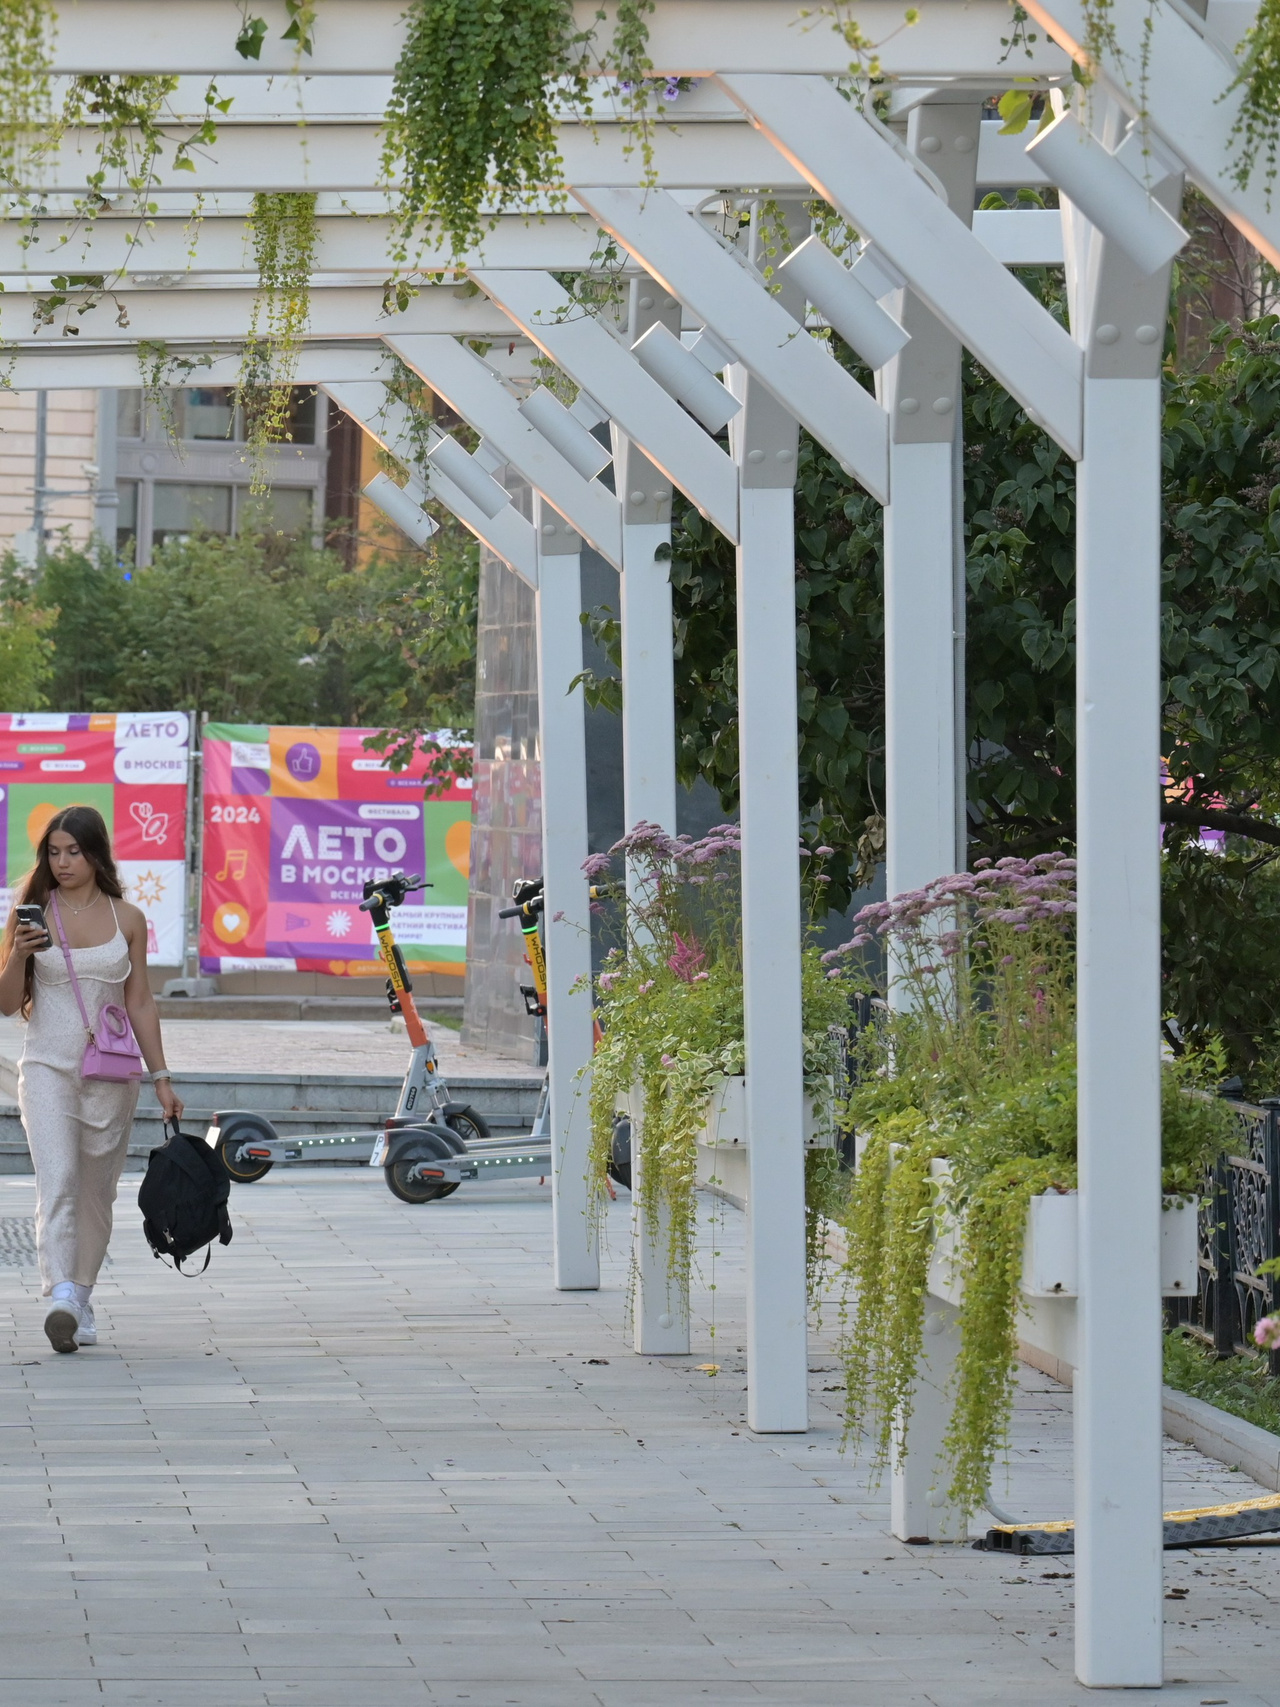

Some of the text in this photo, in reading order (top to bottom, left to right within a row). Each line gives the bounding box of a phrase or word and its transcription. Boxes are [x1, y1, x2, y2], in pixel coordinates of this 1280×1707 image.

[125, 722, 179, 738] ЛЕТО
[124, 760, 183, 770] В МОСКВЕ
[211, 805, 261, 824] 2024
[367, 808, 411, 816] ФЕСТИВАЛЬ
[280, 824, 407, 863] ЛЕТО
[281, 865, 296, 883] В
[330, 890, 349, 900] ВСЕ
[380, 935, 402, 989] WHOOSH
